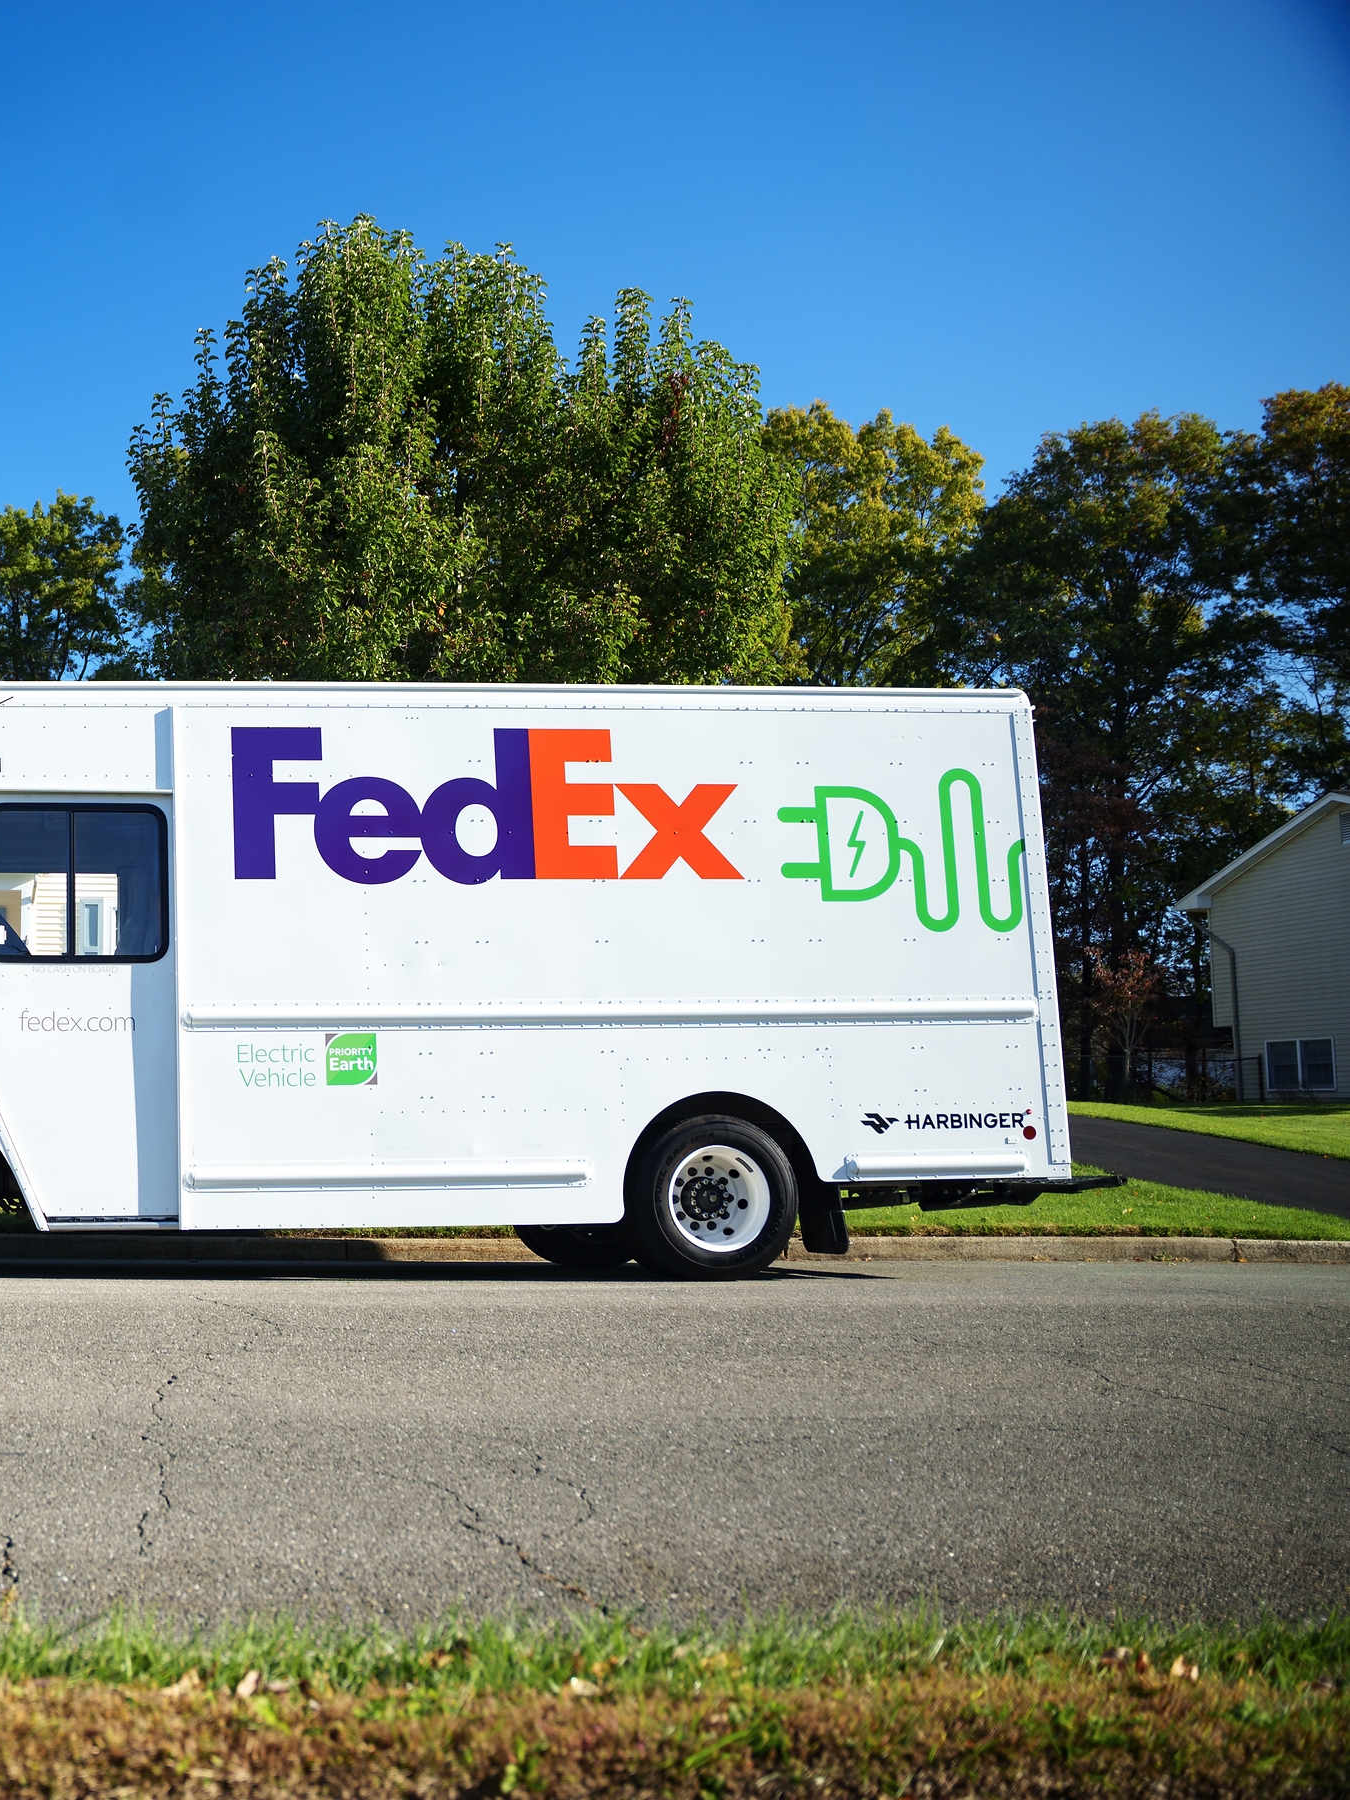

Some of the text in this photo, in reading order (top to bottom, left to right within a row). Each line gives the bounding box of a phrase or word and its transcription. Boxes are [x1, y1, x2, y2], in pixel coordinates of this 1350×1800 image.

[231, 727, 745, 885] FedEx
[32, 965, 119, 974] NO CASH ON BOARD
[18, 1010, 136, 1032] fedex.com
[237, 1043, 315, 1063] Electric
[329, 1046, 373, 1056] PRIORITY
[329, 1056, 374, 1071] Earth
[239, 1067, 316, 1087] Vehicle
[904, 1113, 1024, 1129] HARBINGER
